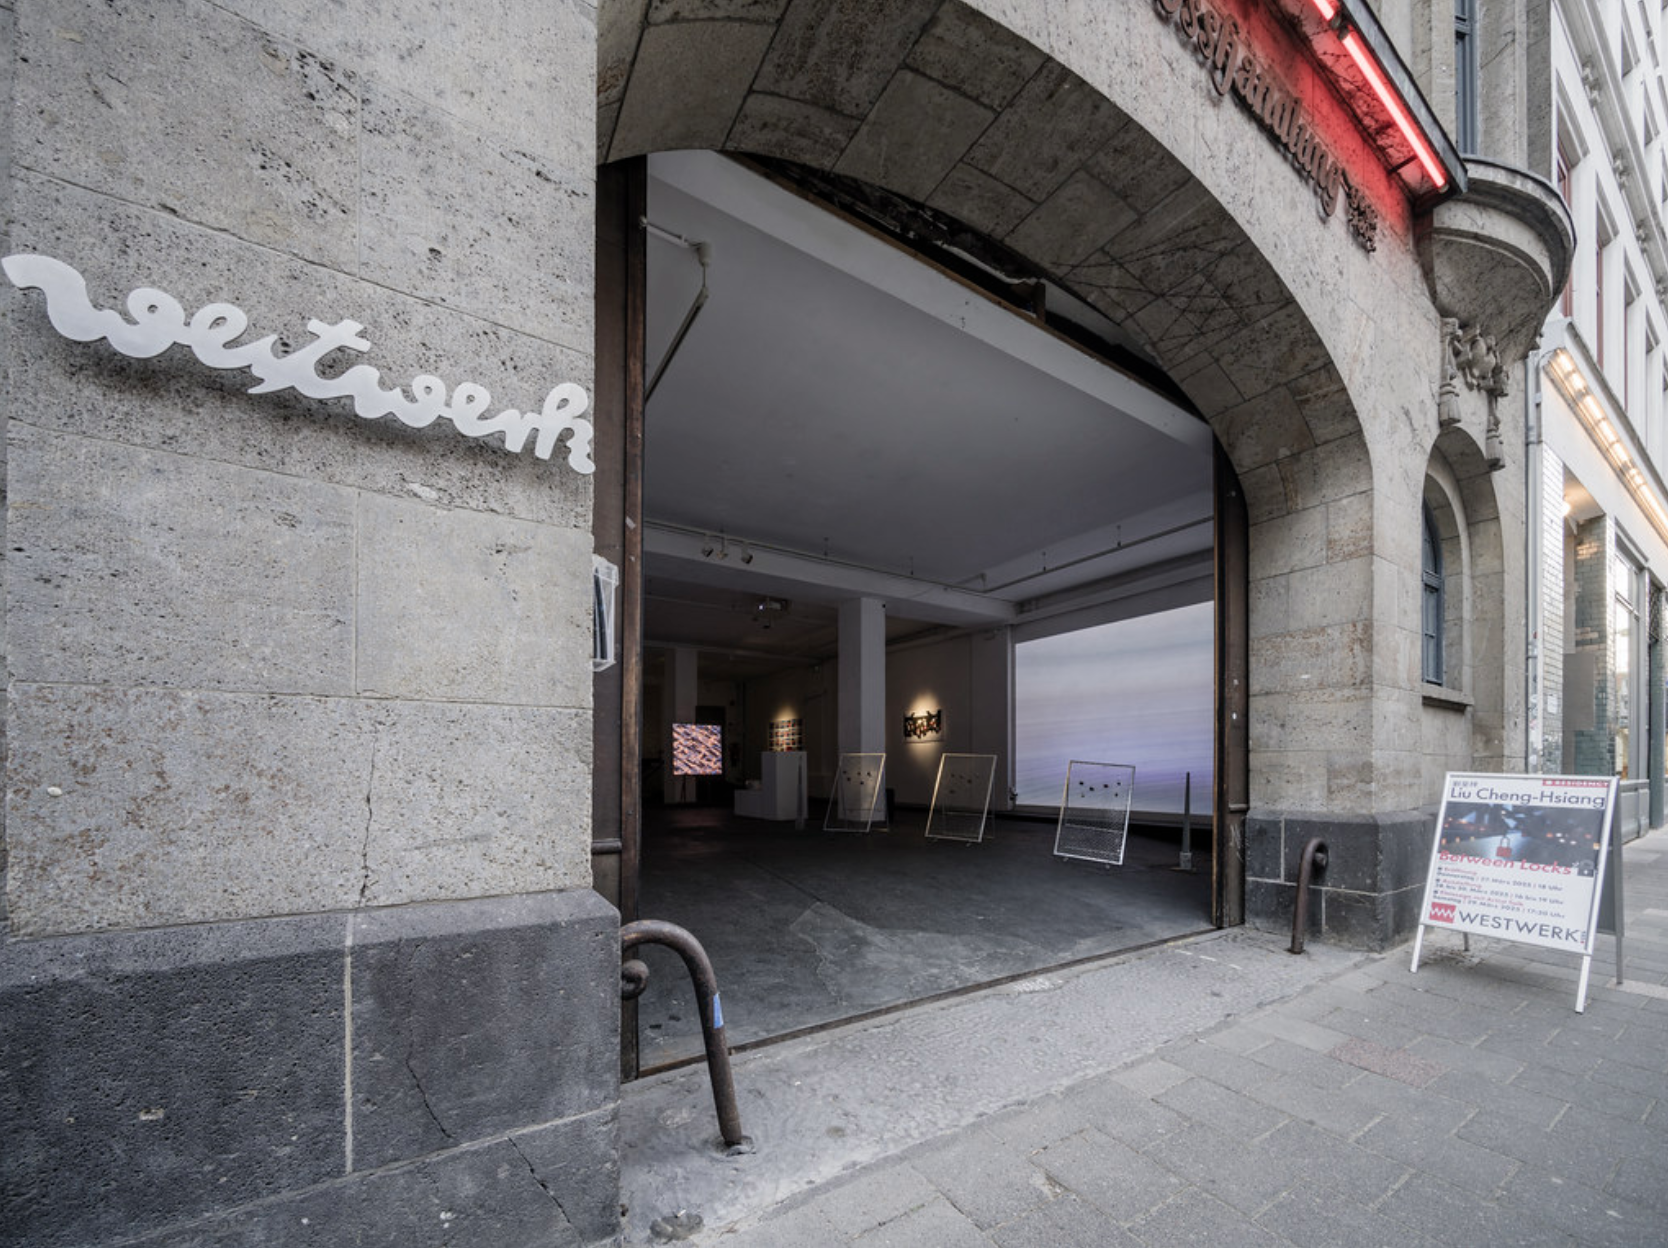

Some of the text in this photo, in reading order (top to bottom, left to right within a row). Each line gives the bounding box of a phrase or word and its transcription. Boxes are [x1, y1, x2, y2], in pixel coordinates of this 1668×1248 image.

[1451, 787, 1605, 808] Liu Cheng-Hsiang
[1439, 850, 1572, 875] Between Locks
[1458, 910, 1580, 943] WESTWERK
